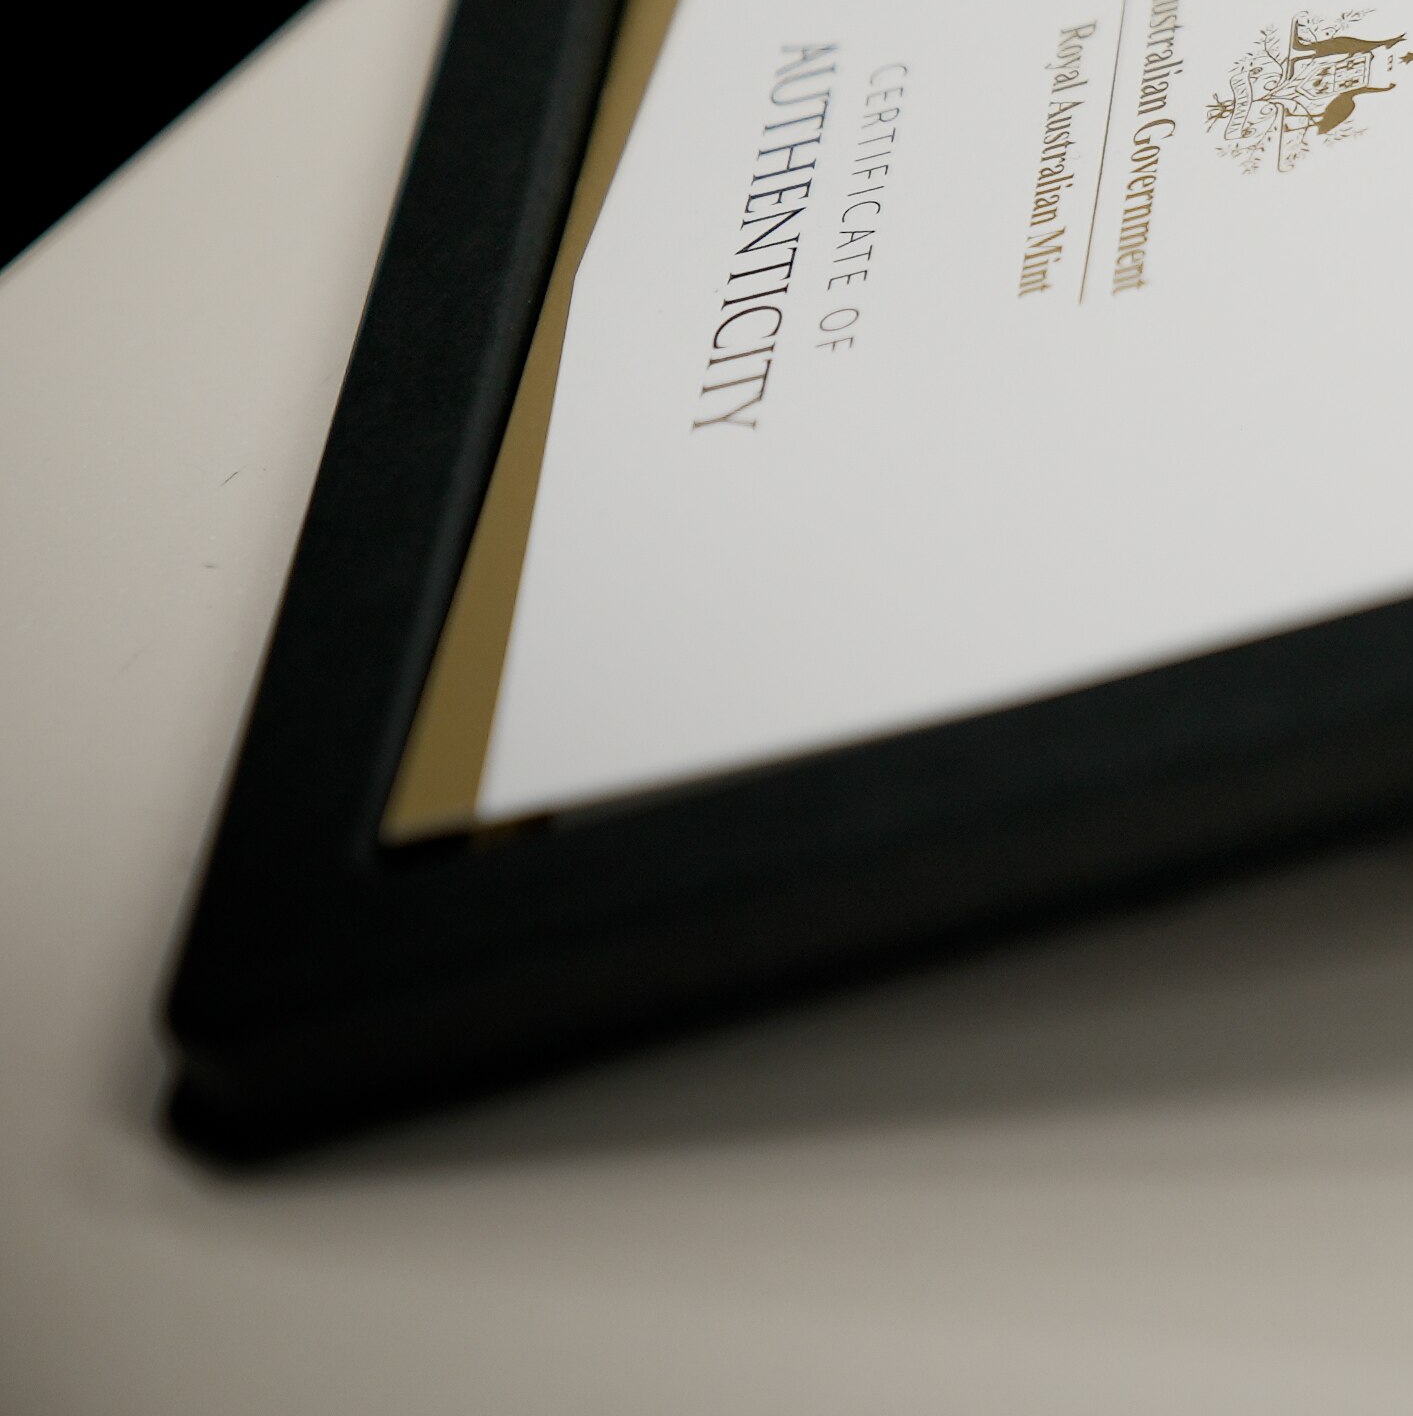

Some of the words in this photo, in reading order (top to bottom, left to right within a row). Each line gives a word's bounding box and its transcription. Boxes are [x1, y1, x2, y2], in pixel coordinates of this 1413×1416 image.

[1042, 18, 1098, 98] Royal
[825, 62, 909, 293] CERTIFICATE
[1029, 99, 1087, 228] Australian
[1111, 116, 1177, 297] Government
[690, 40, 841, 432] AUTHENTICITY
[1017, 225, 1068, 300] Mint
[815, 306, 861, 353] OF
